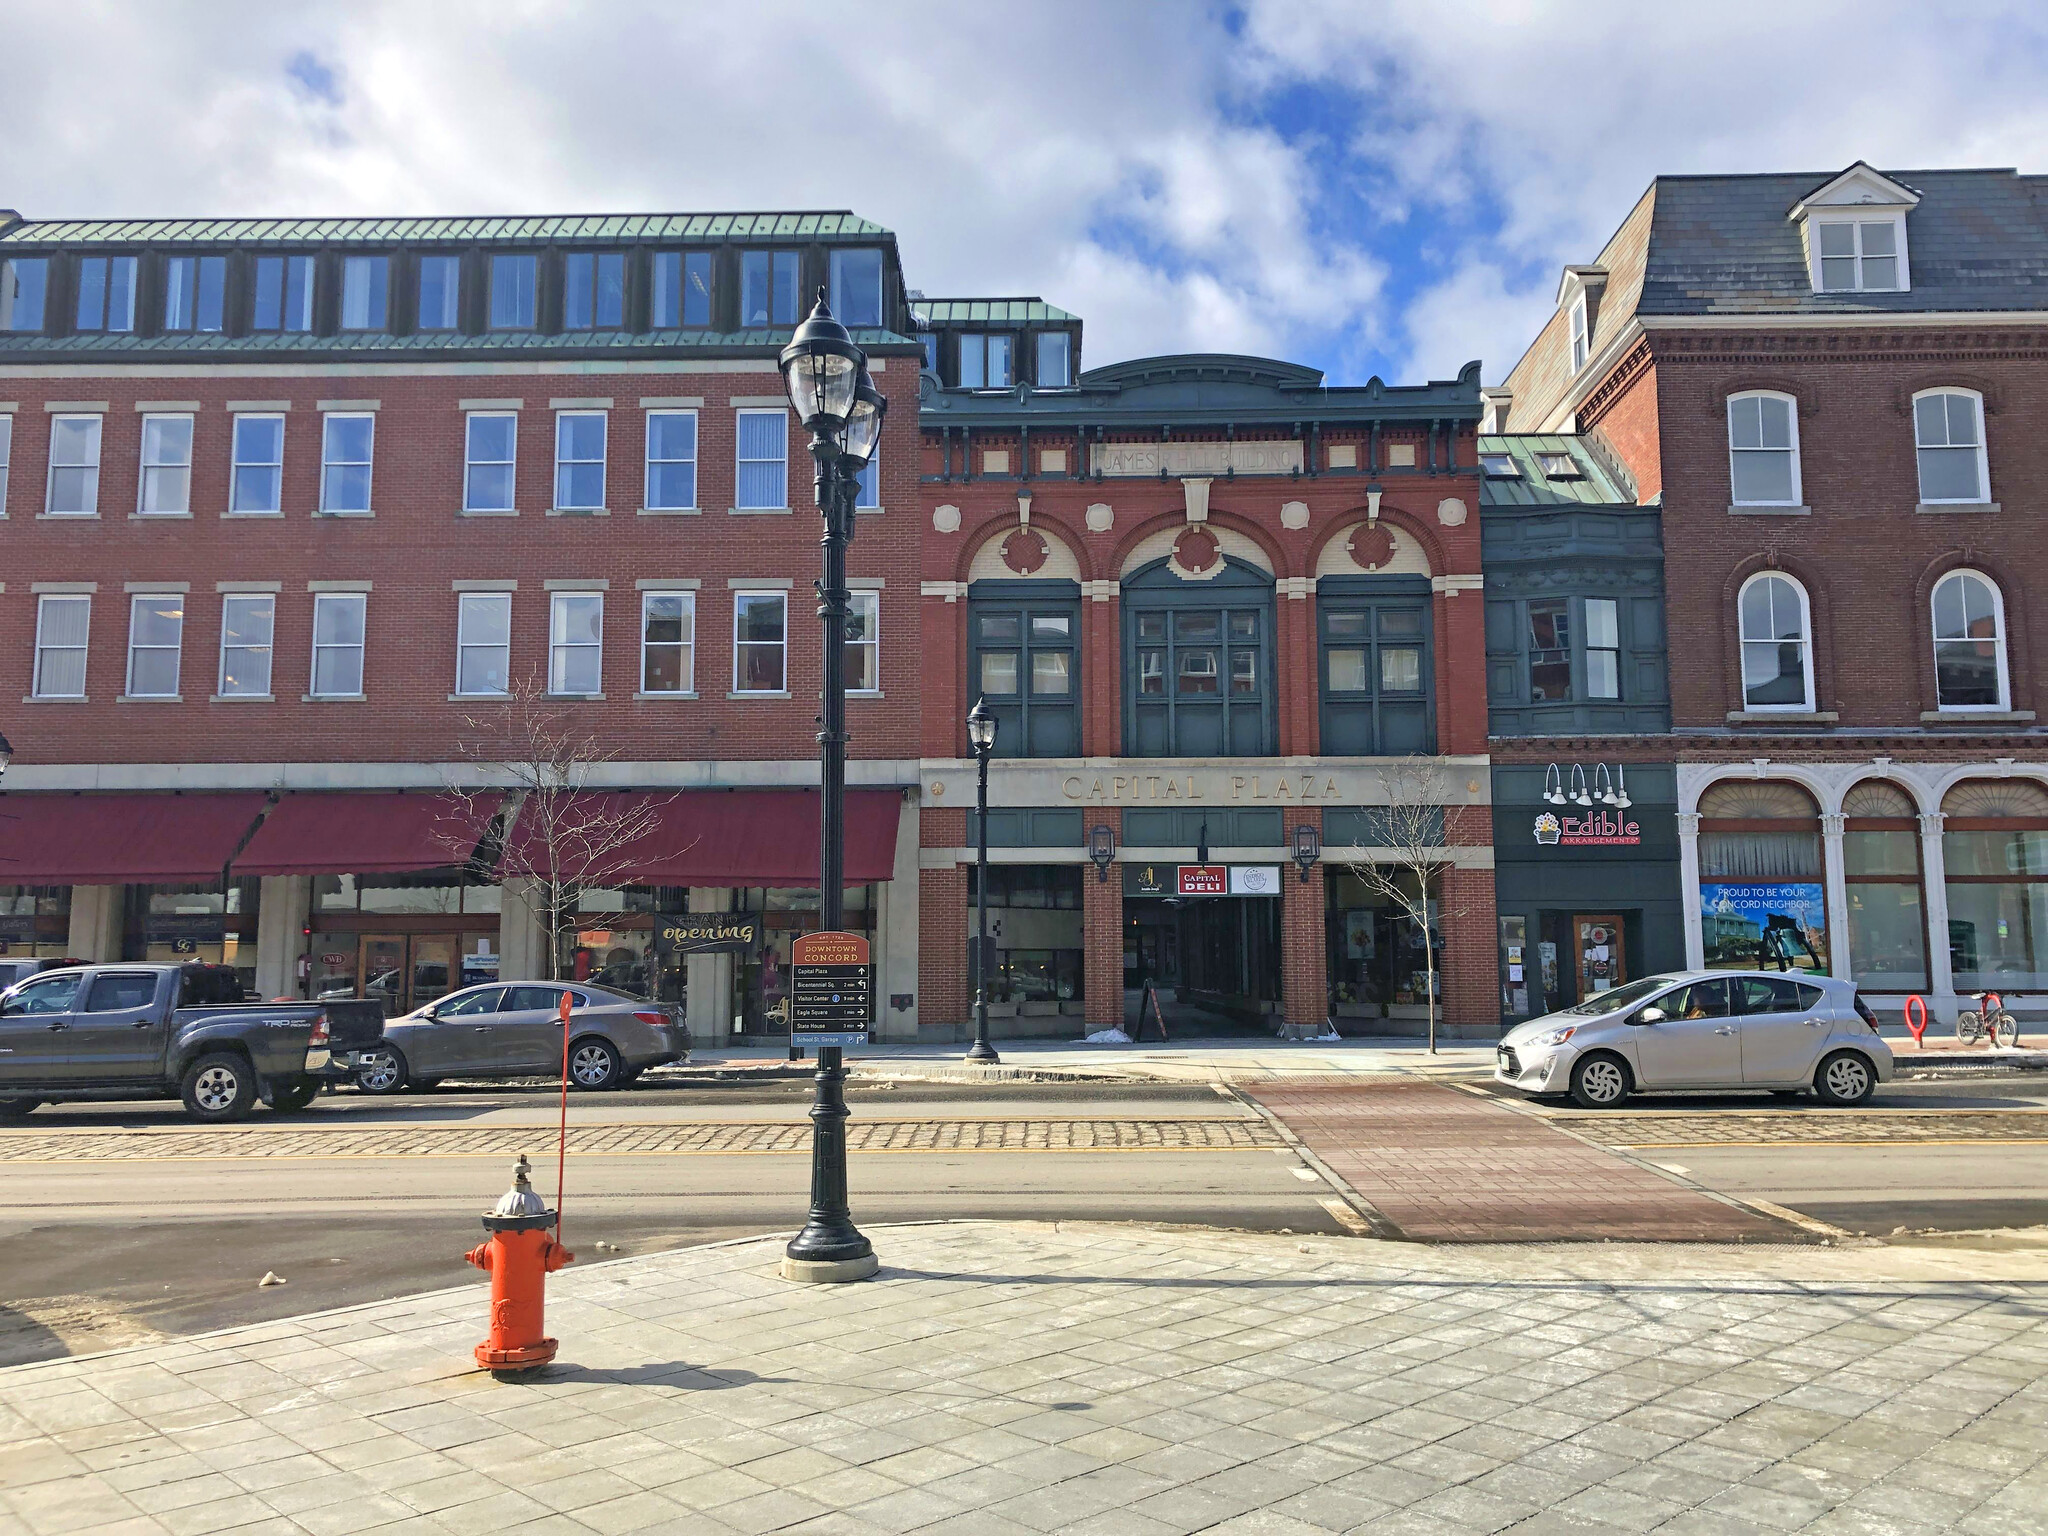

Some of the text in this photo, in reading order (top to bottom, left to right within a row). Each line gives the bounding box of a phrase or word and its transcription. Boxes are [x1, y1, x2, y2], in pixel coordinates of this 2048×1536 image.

[1104, 451, 1155, 470] JAMES
[1177, 451, 1213, 469] HILL
[1061, 775, 1343, 800] CAPITAL PLAZA
[1561, 810, 1640, 836] Edible
[1184, 874, 1220, 882] CAPITAL
[1185, 883, 1220, 891] DELI
[1718, 888, 1806, 897] PROUD TO BE YOUR
[1713, 900, 1761, 909] CONCORD
[673, 914, 739, 926] GRAND
[663, 925, 754, 943] opening
[323, 955, 342, 963] CWB
[804, 954, 858, 962] CONCORD
[262, 1019, 290, 1028] TRD
